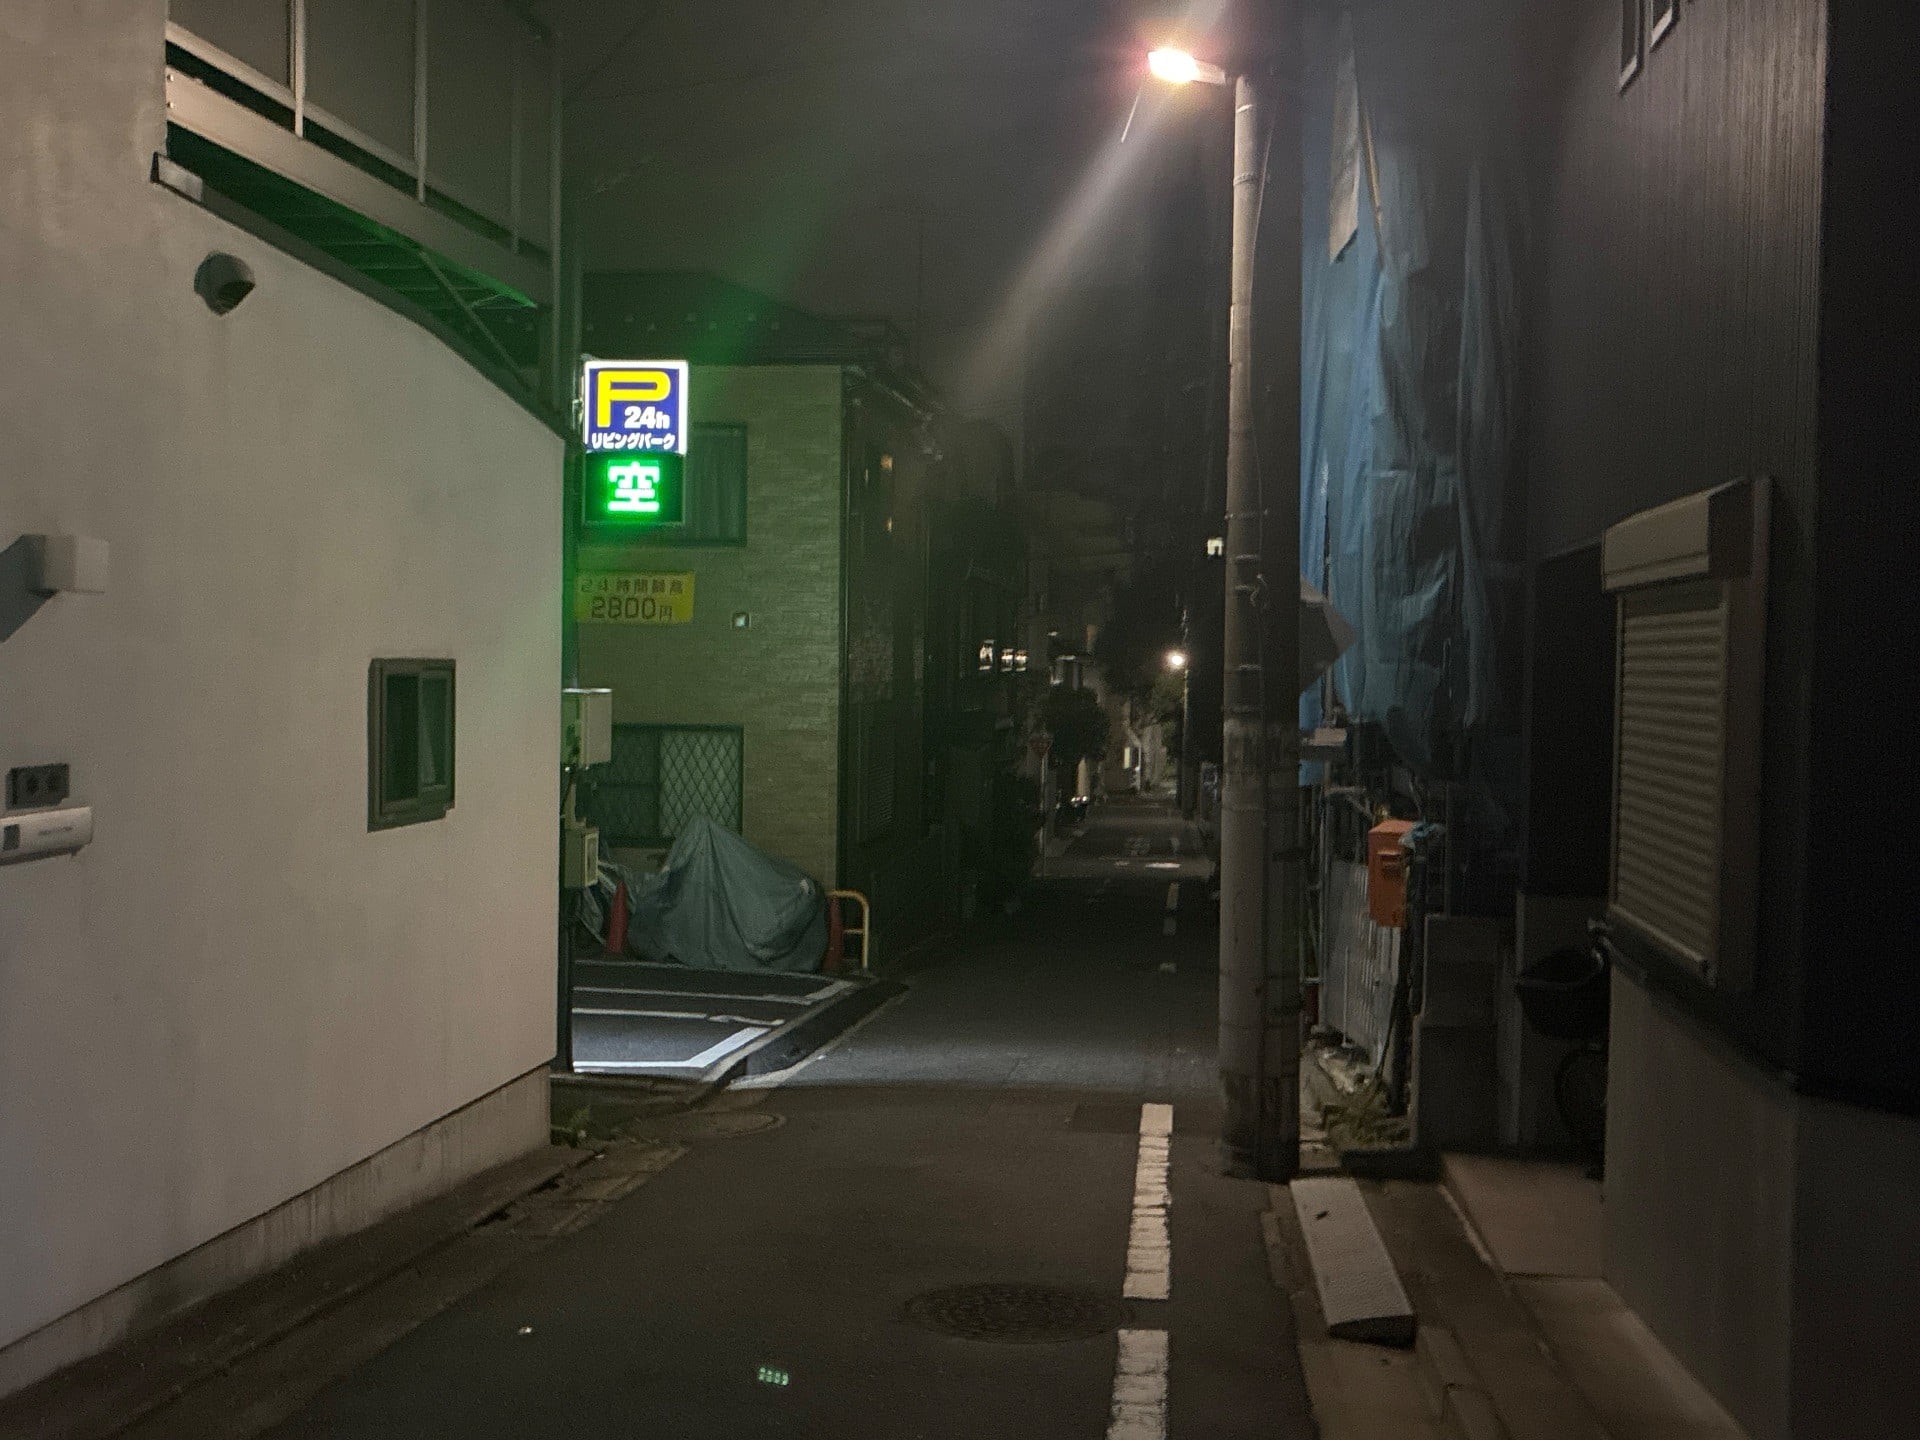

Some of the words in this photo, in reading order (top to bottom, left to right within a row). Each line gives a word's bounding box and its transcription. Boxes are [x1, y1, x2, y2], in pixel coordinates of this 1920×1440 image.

[597, 371, 671, 428] P
[624, 405, 671, 429] 24h
[591, 432, 676, 449] リビングパーク
[608, 461, 660, 512] 空
[591, 597, 673, 621] 2800円
